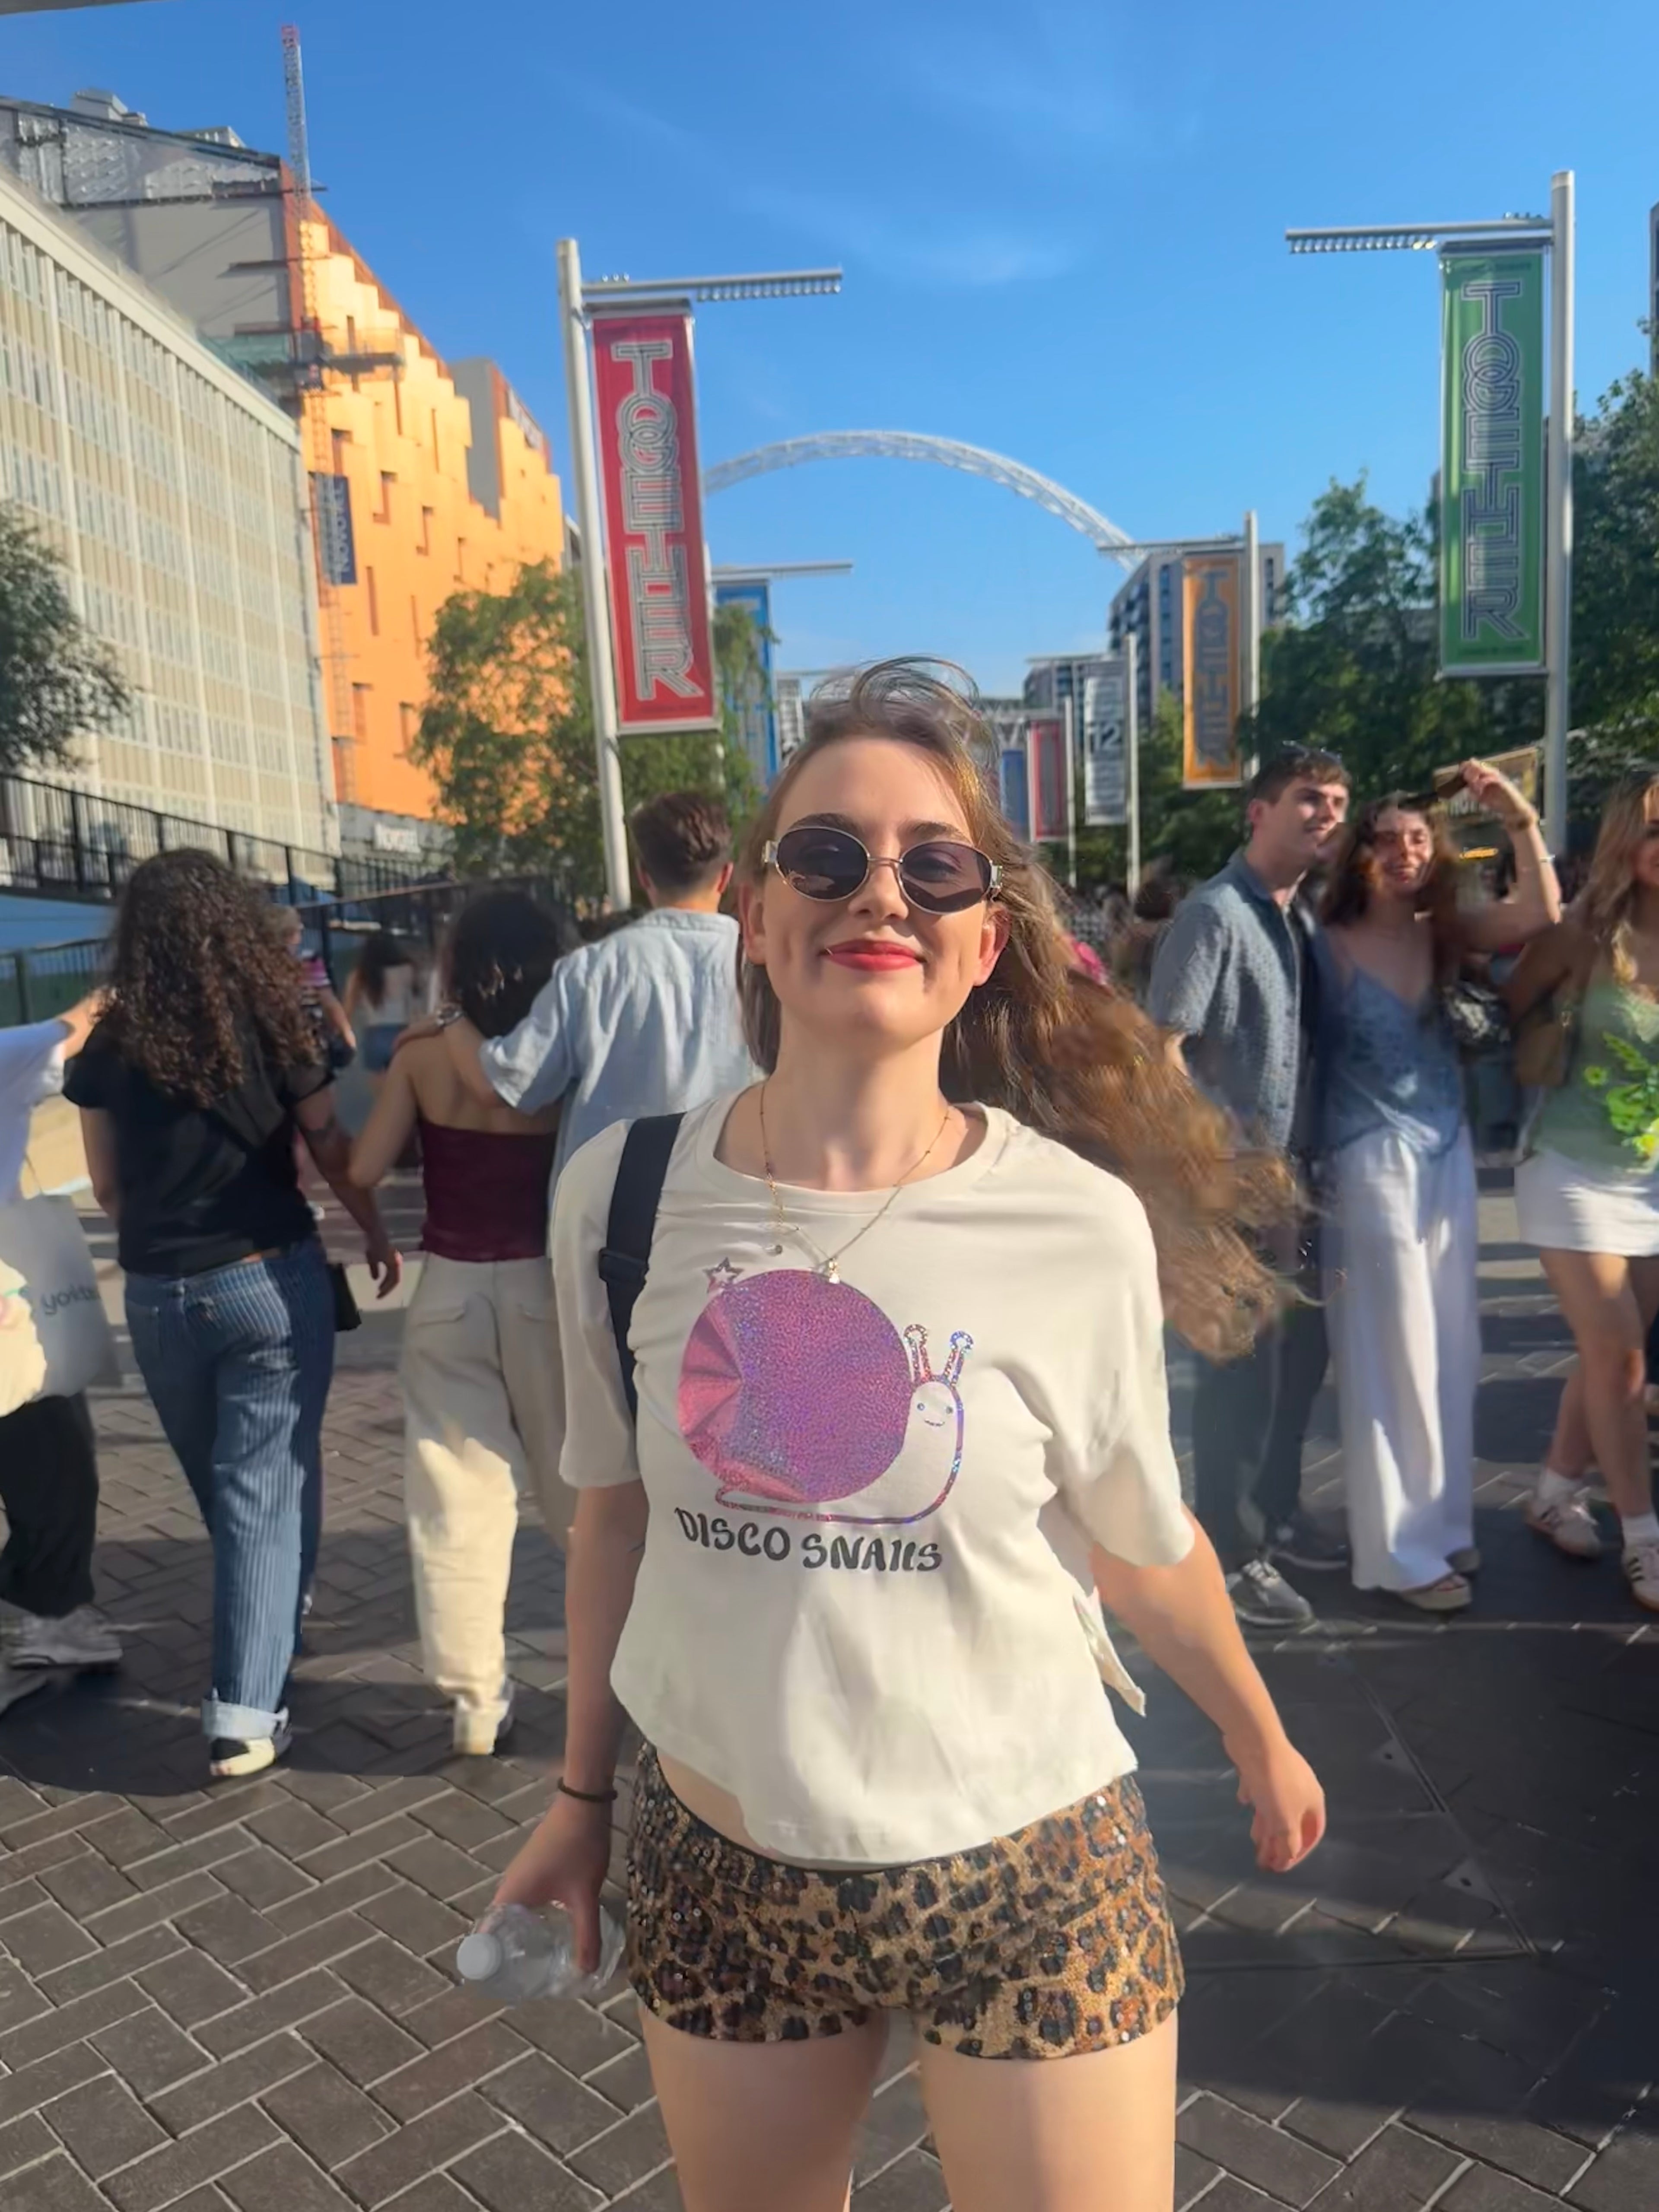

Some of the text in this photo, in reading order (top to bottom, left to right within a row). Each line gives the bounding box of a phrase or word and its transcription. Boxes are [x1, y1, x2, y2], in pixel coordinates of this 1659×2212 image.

[612, 340, 703, 699] TOGETHER
[1462, 282, 1526, 639] TOGETHER
[674, 1507, 791, 1560] DISCO
